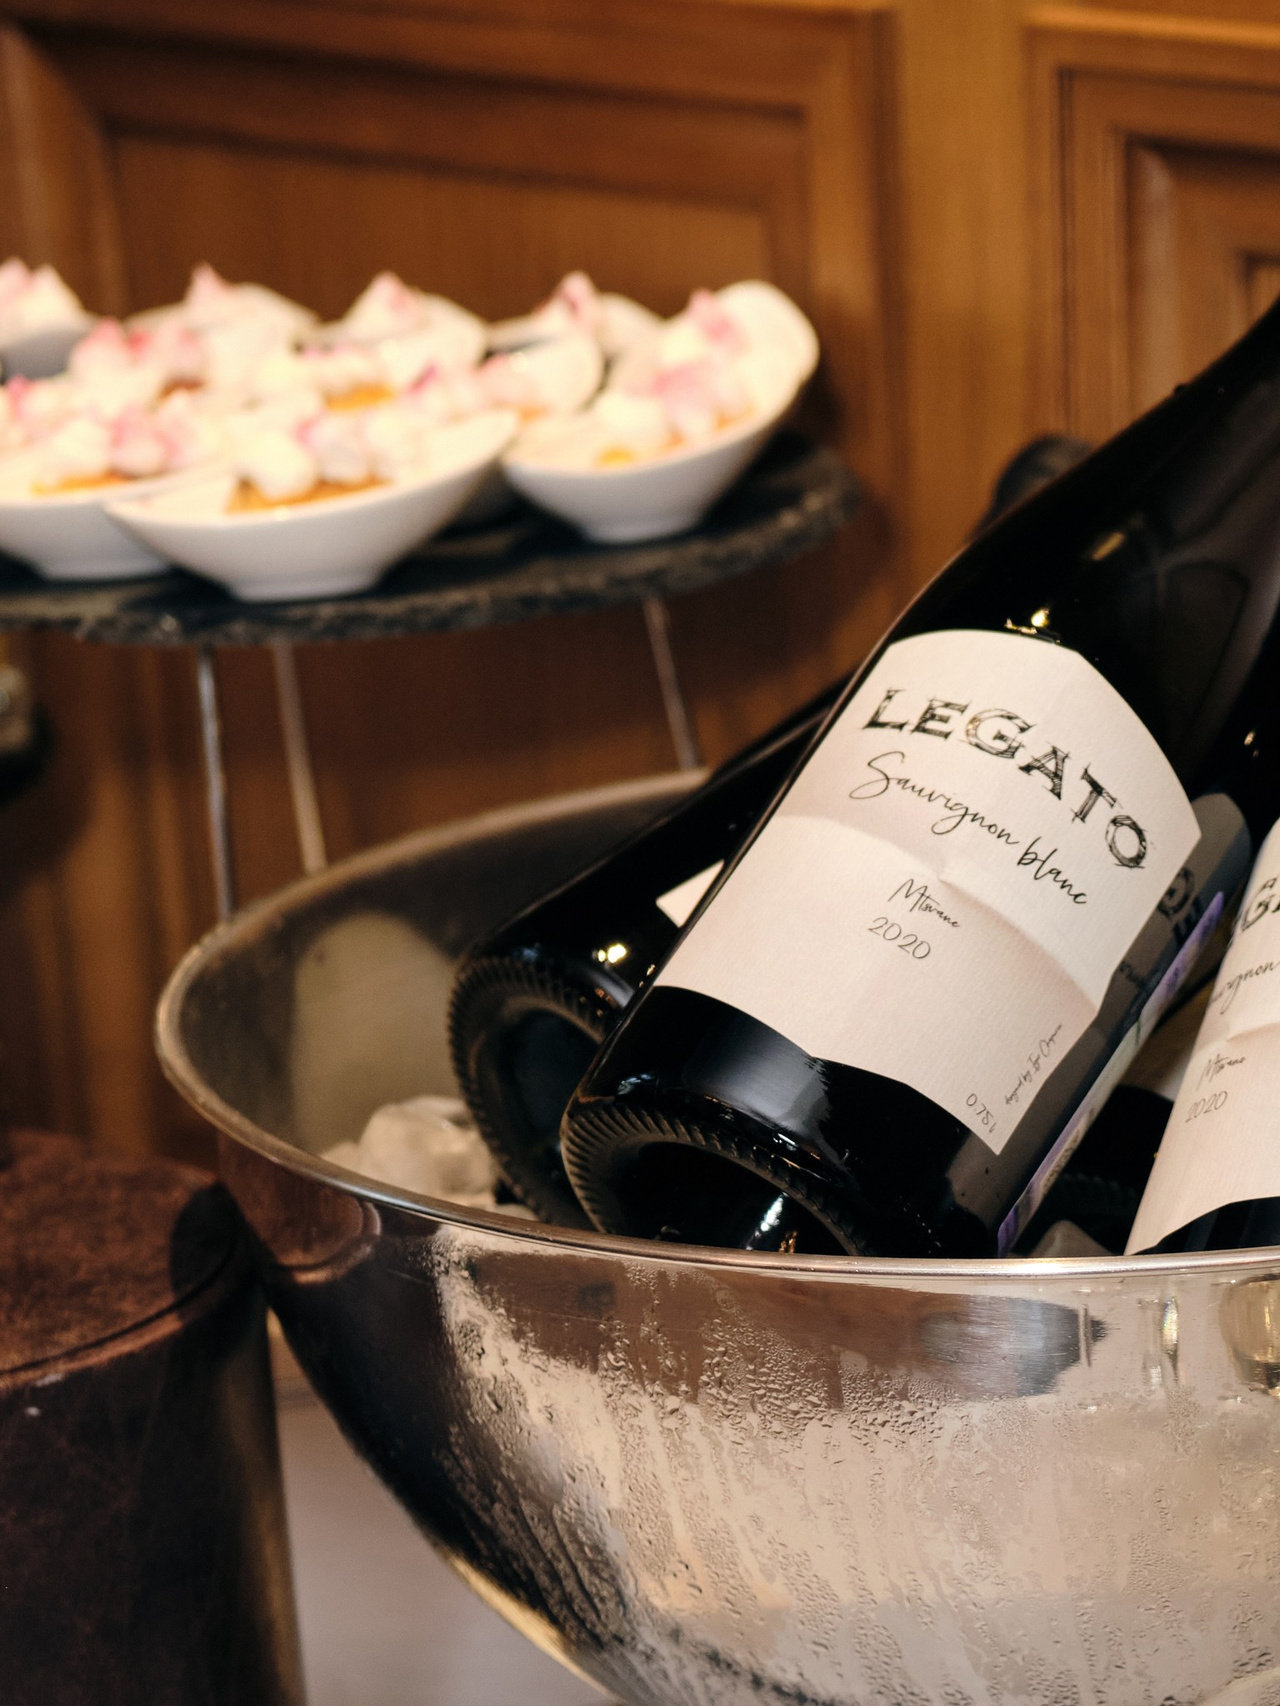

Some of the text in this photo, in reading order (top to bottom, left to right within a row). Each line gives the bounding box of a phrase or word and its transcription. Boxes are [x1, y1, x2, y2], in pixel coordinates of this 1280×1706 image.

[849, 750, 1020, 835] Sauvignon
[1017, 836, 1087, 905] blanc
[861, 688, 1154, 870] LEGATO
[867, 916, 931, 960] 2020
[1184, 1089, 1229, 1123] 2020
